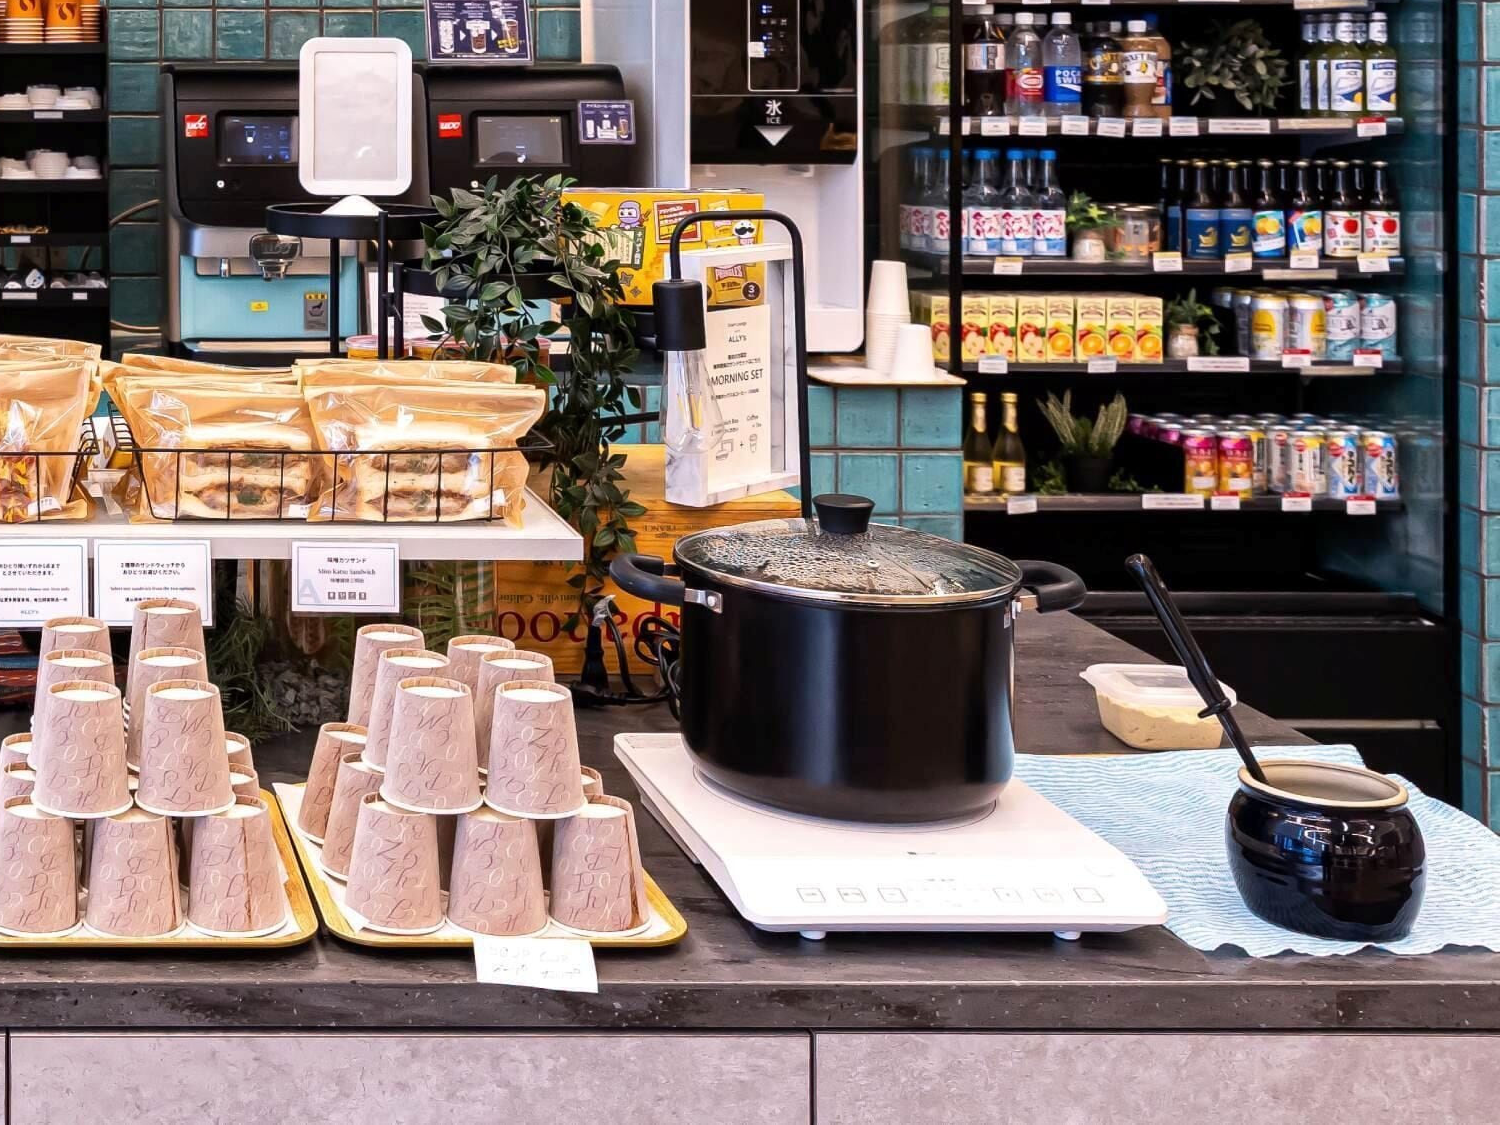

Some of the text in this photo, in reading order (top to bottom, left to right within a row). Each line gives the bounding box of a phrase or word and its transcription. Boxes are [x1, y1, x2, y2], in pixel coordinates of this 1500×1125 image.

[765, 99, 783, 116] 氷
[748, 285, 756, 294] 3
[711, 368, 764, 387] MORNING SET
